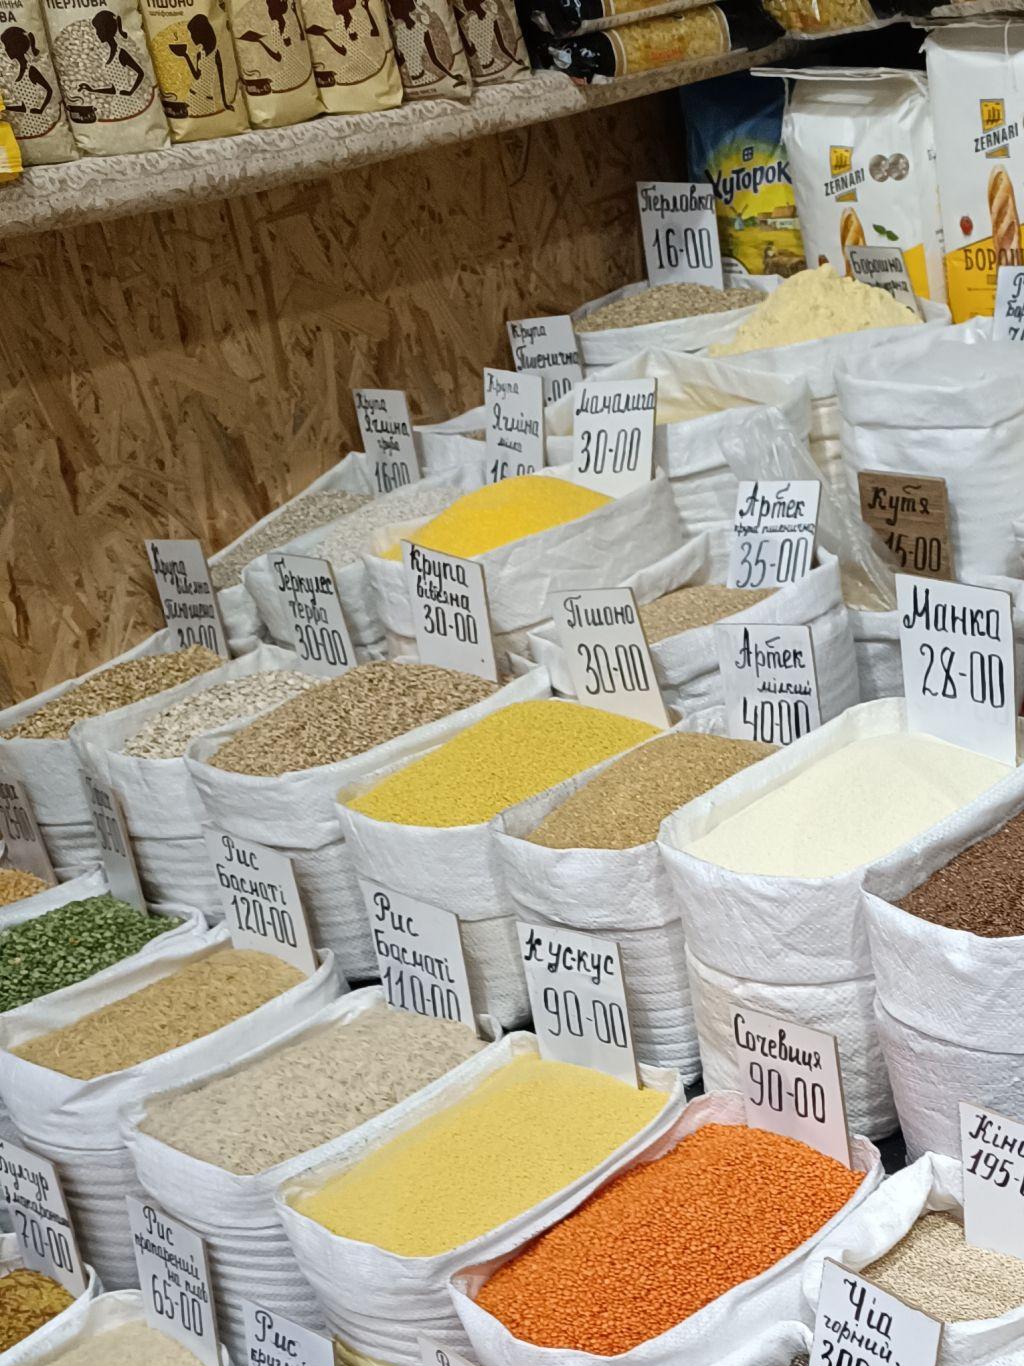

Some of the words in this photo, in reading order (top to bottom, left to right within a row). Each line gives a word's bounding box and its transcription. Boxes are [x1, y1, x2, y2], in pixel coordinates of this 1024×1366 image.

[974, 123, 1019, 152] ZERNARI
[640, 184, 715, 219] Перловка
[824, 168, 866, 197] ZERNARI
[651, 227, 713, 270] 16-00
[578, 427, 641, 475] 30-00
[739, 481, 805, 527] Артек
[868, 485, 930, 526] Кутя
[410, 544, 468, 591] Крупа
[736, 537, 808, 588] 35-00
[424, 604, 478, 645] 30-00
[564, 595, 635, 629] Пшоно
[903, 585, 1001, 642] Манка
[295, 624, 348, 666] 30-00
[735, 627, 806, 677] Артек
[578, 643, 650, 696] 30-00
[920, 643, 1005, 709] 28-00
[743, 697, 810, 745] 40-00
[222, 835, 259, 871] Рис
[216, 863, 288, 905] Басматі
[231, 895, 298, 948] 120-00
[373, 892, 419, 937] Рис
[374, 929, 455, 983] Басматі
[383, 966, 462, 1023] 110-00
[543, 987, 628, 1048] 90-00
[733, 1013, 823, 1071] Сочевиця
[750, 1062, 826, 1124] 90-00
[15, 1210, 74, 1273] 70-00
[143, 1205, 174, 1246] Рис
[152, 1274, 203, 1337] 65-00
[255, 1310, 297, 1357] Рис
